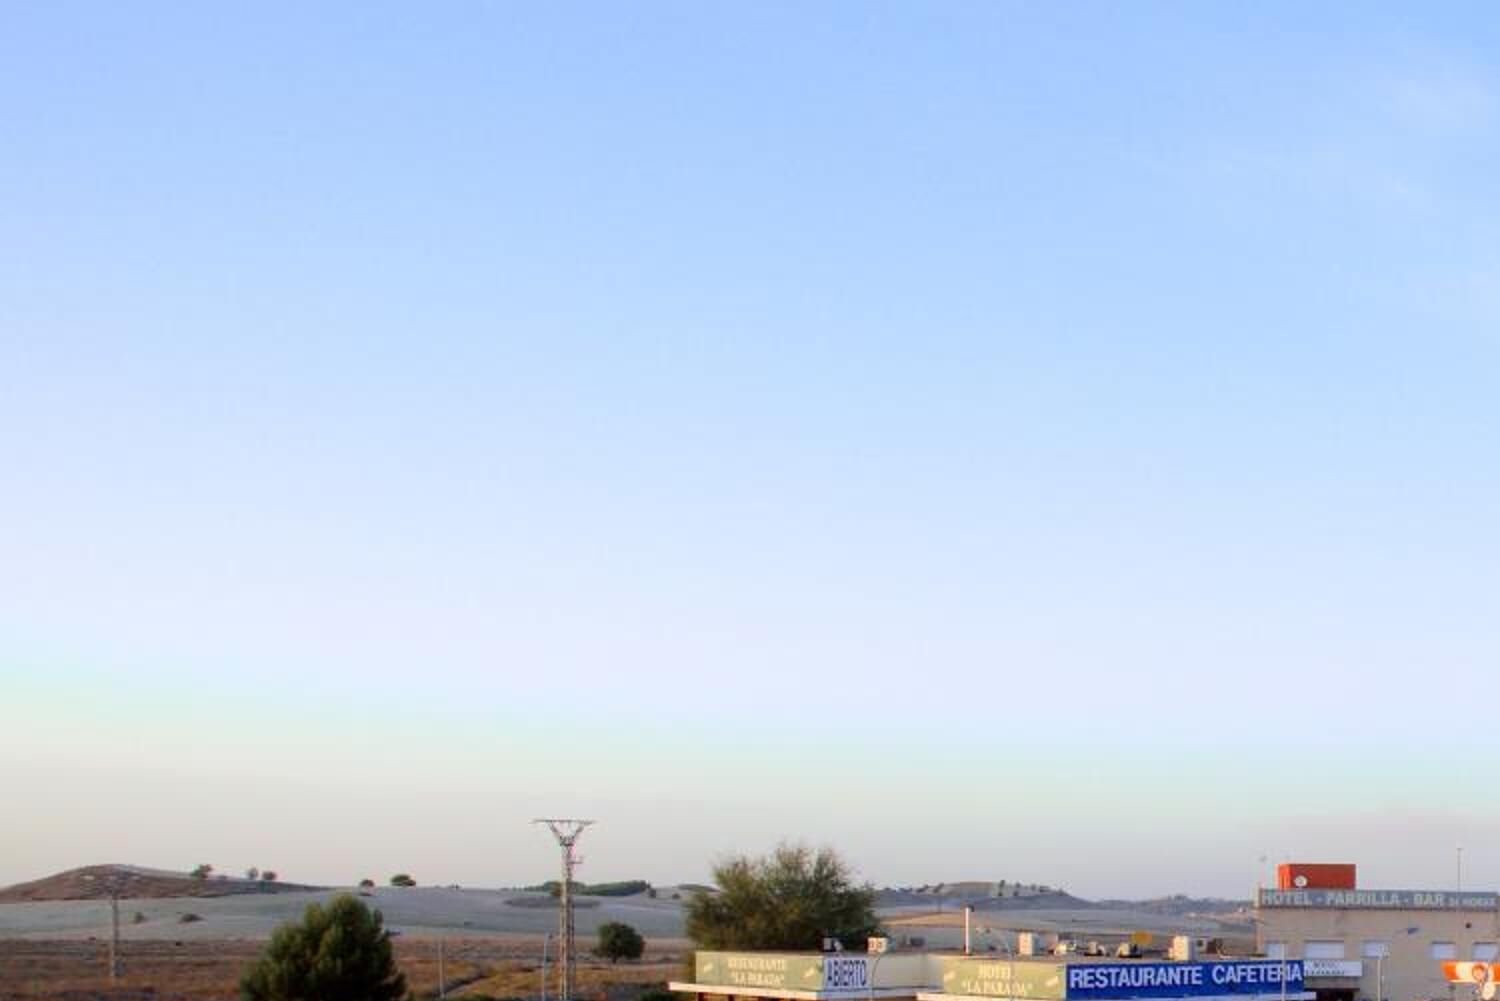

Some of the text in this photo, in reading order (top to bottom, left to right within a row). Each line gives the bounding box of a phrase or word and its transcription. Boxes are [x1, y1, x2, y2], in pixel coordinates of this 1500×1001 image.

[1261, 892, 1312, 906] HOTEL
[1413, 893, 1444, 907] BAR
[827, 959, 867, 988] ABIERTO
[1069, 966, 1203, 989] RESTAURANTE
[1212, 963, 1303, 984] CAFETERIA
